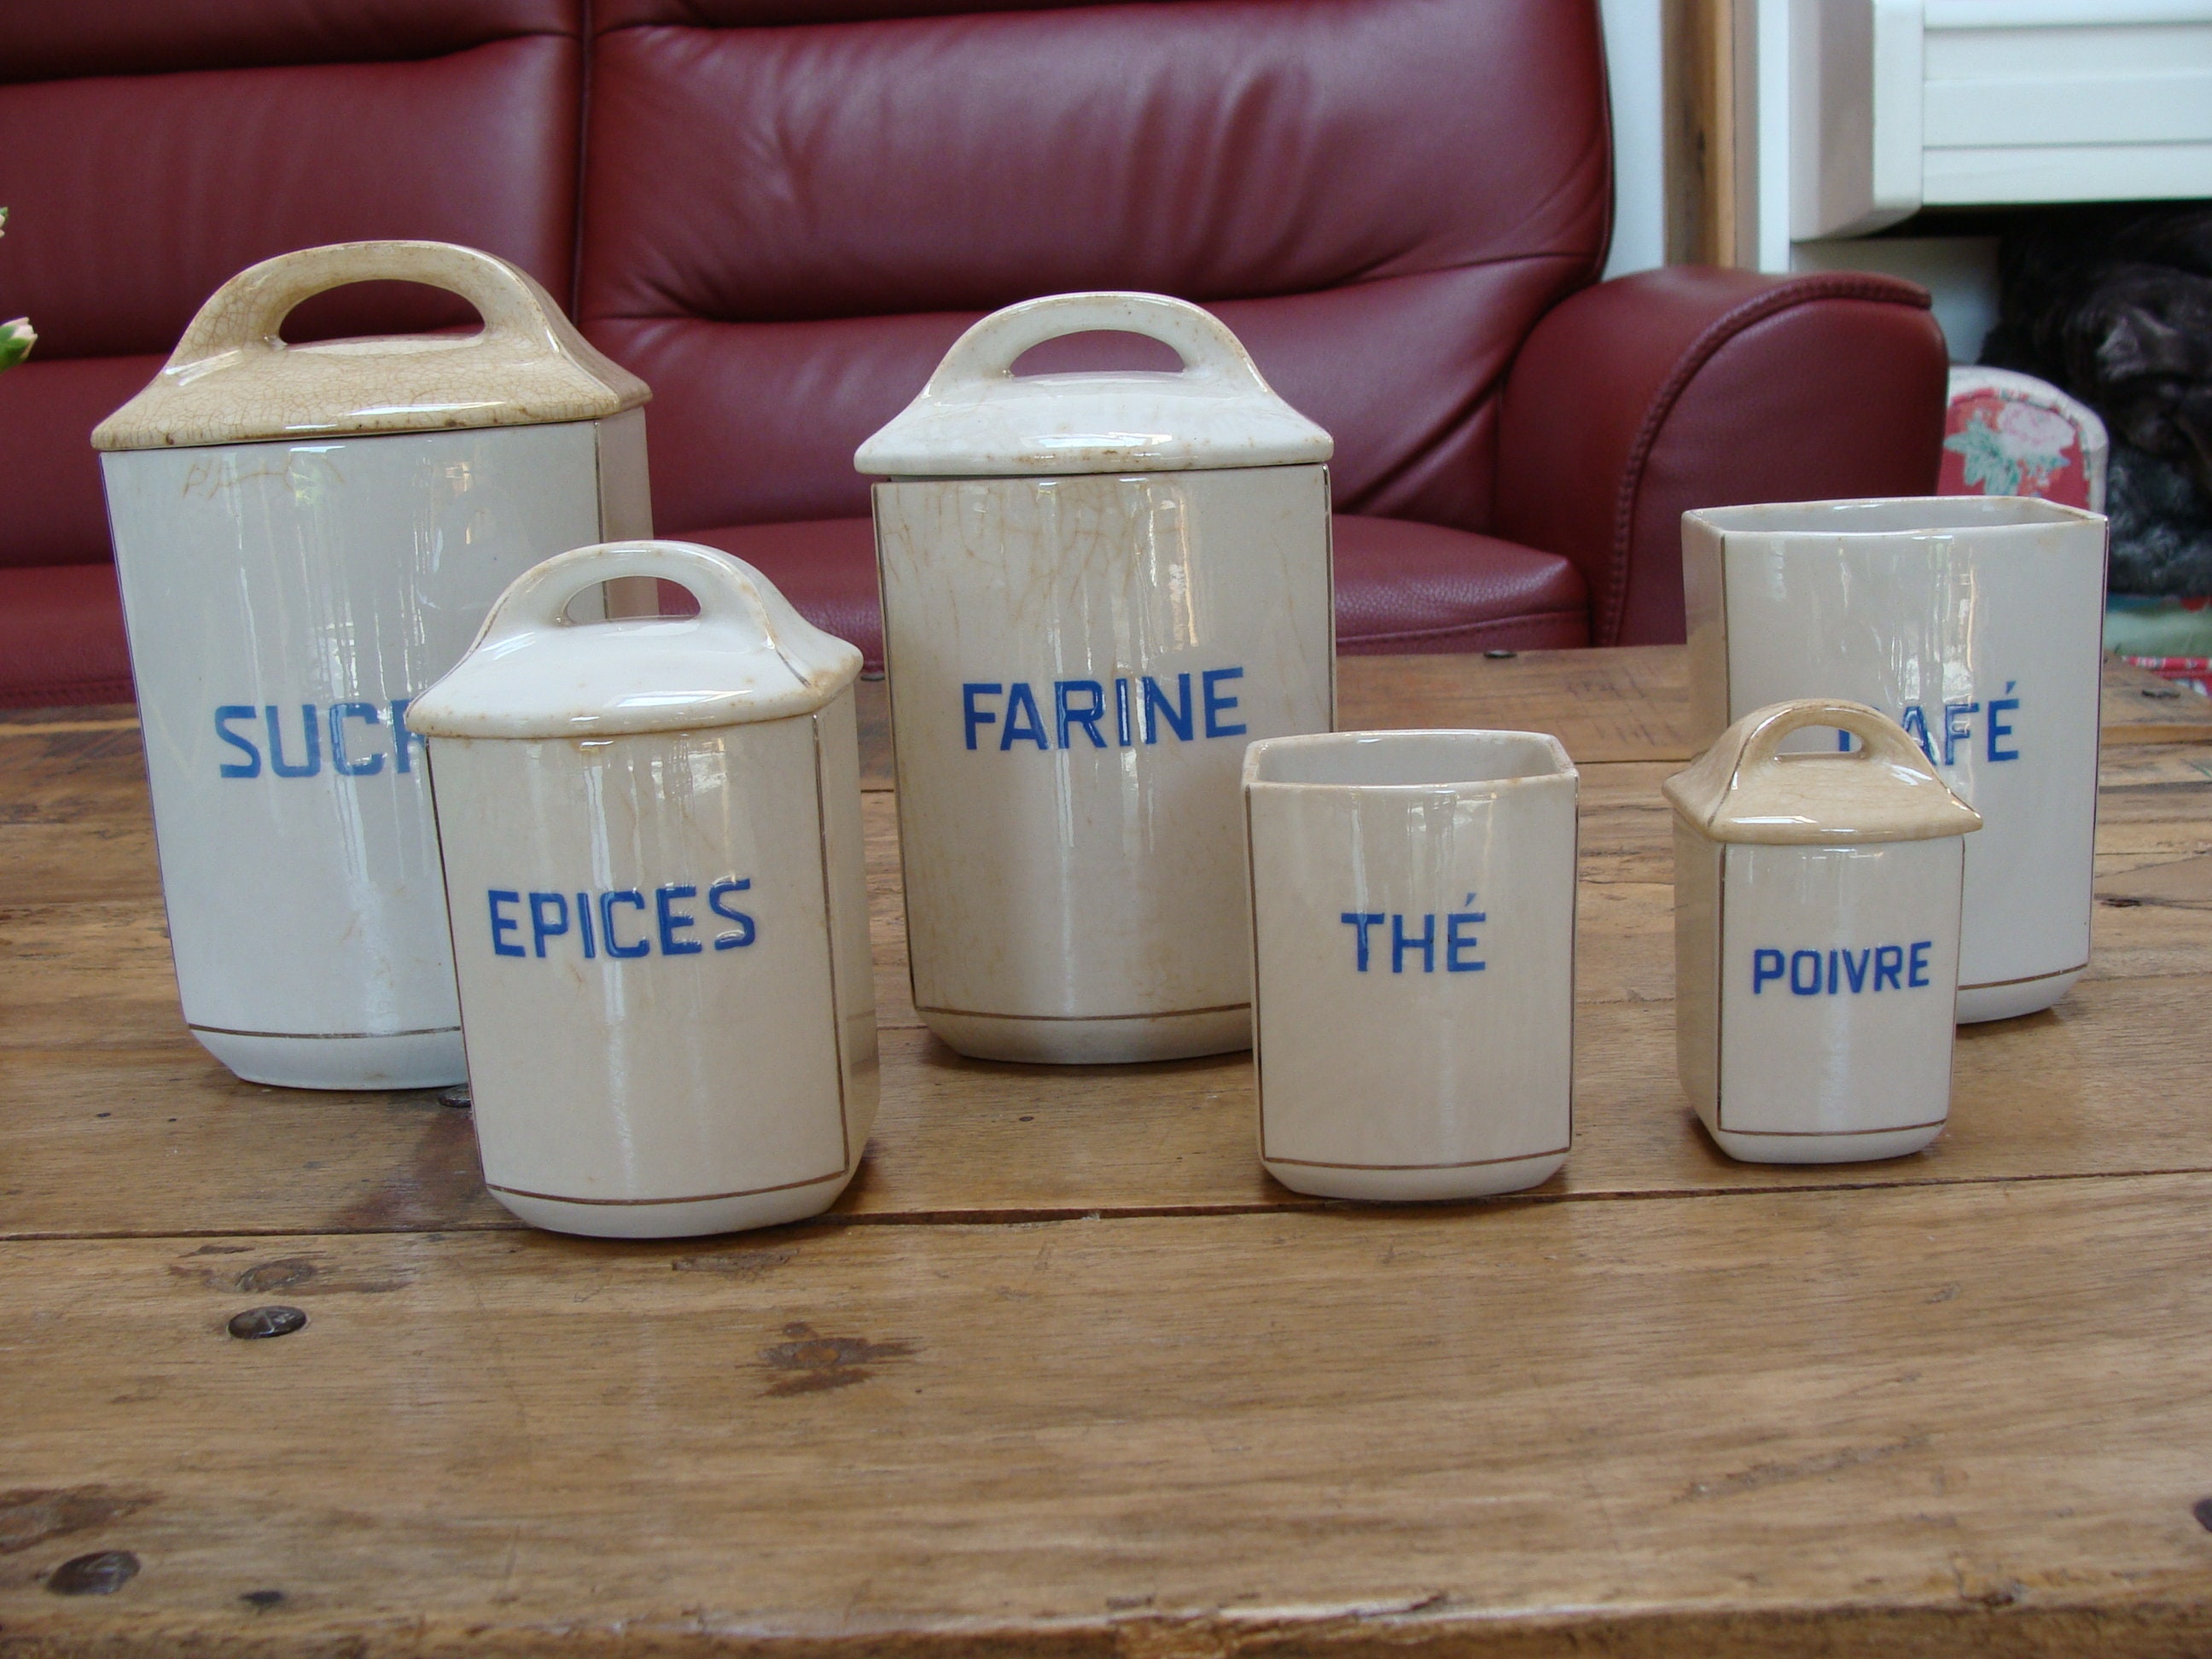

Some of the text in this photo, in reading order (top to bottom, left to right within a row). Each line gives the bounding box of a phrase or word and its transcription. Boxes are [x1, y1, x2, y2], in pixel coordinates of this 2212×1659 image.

[962, 667, 1248, 751] FARINE
[1838, 680, 2021, 766] AFÉ
[487, 879, 757, 960] EPICES
[1341, 893, 1487, 973] THÉ
[1754, 940, 1933, 997] POIVRE
